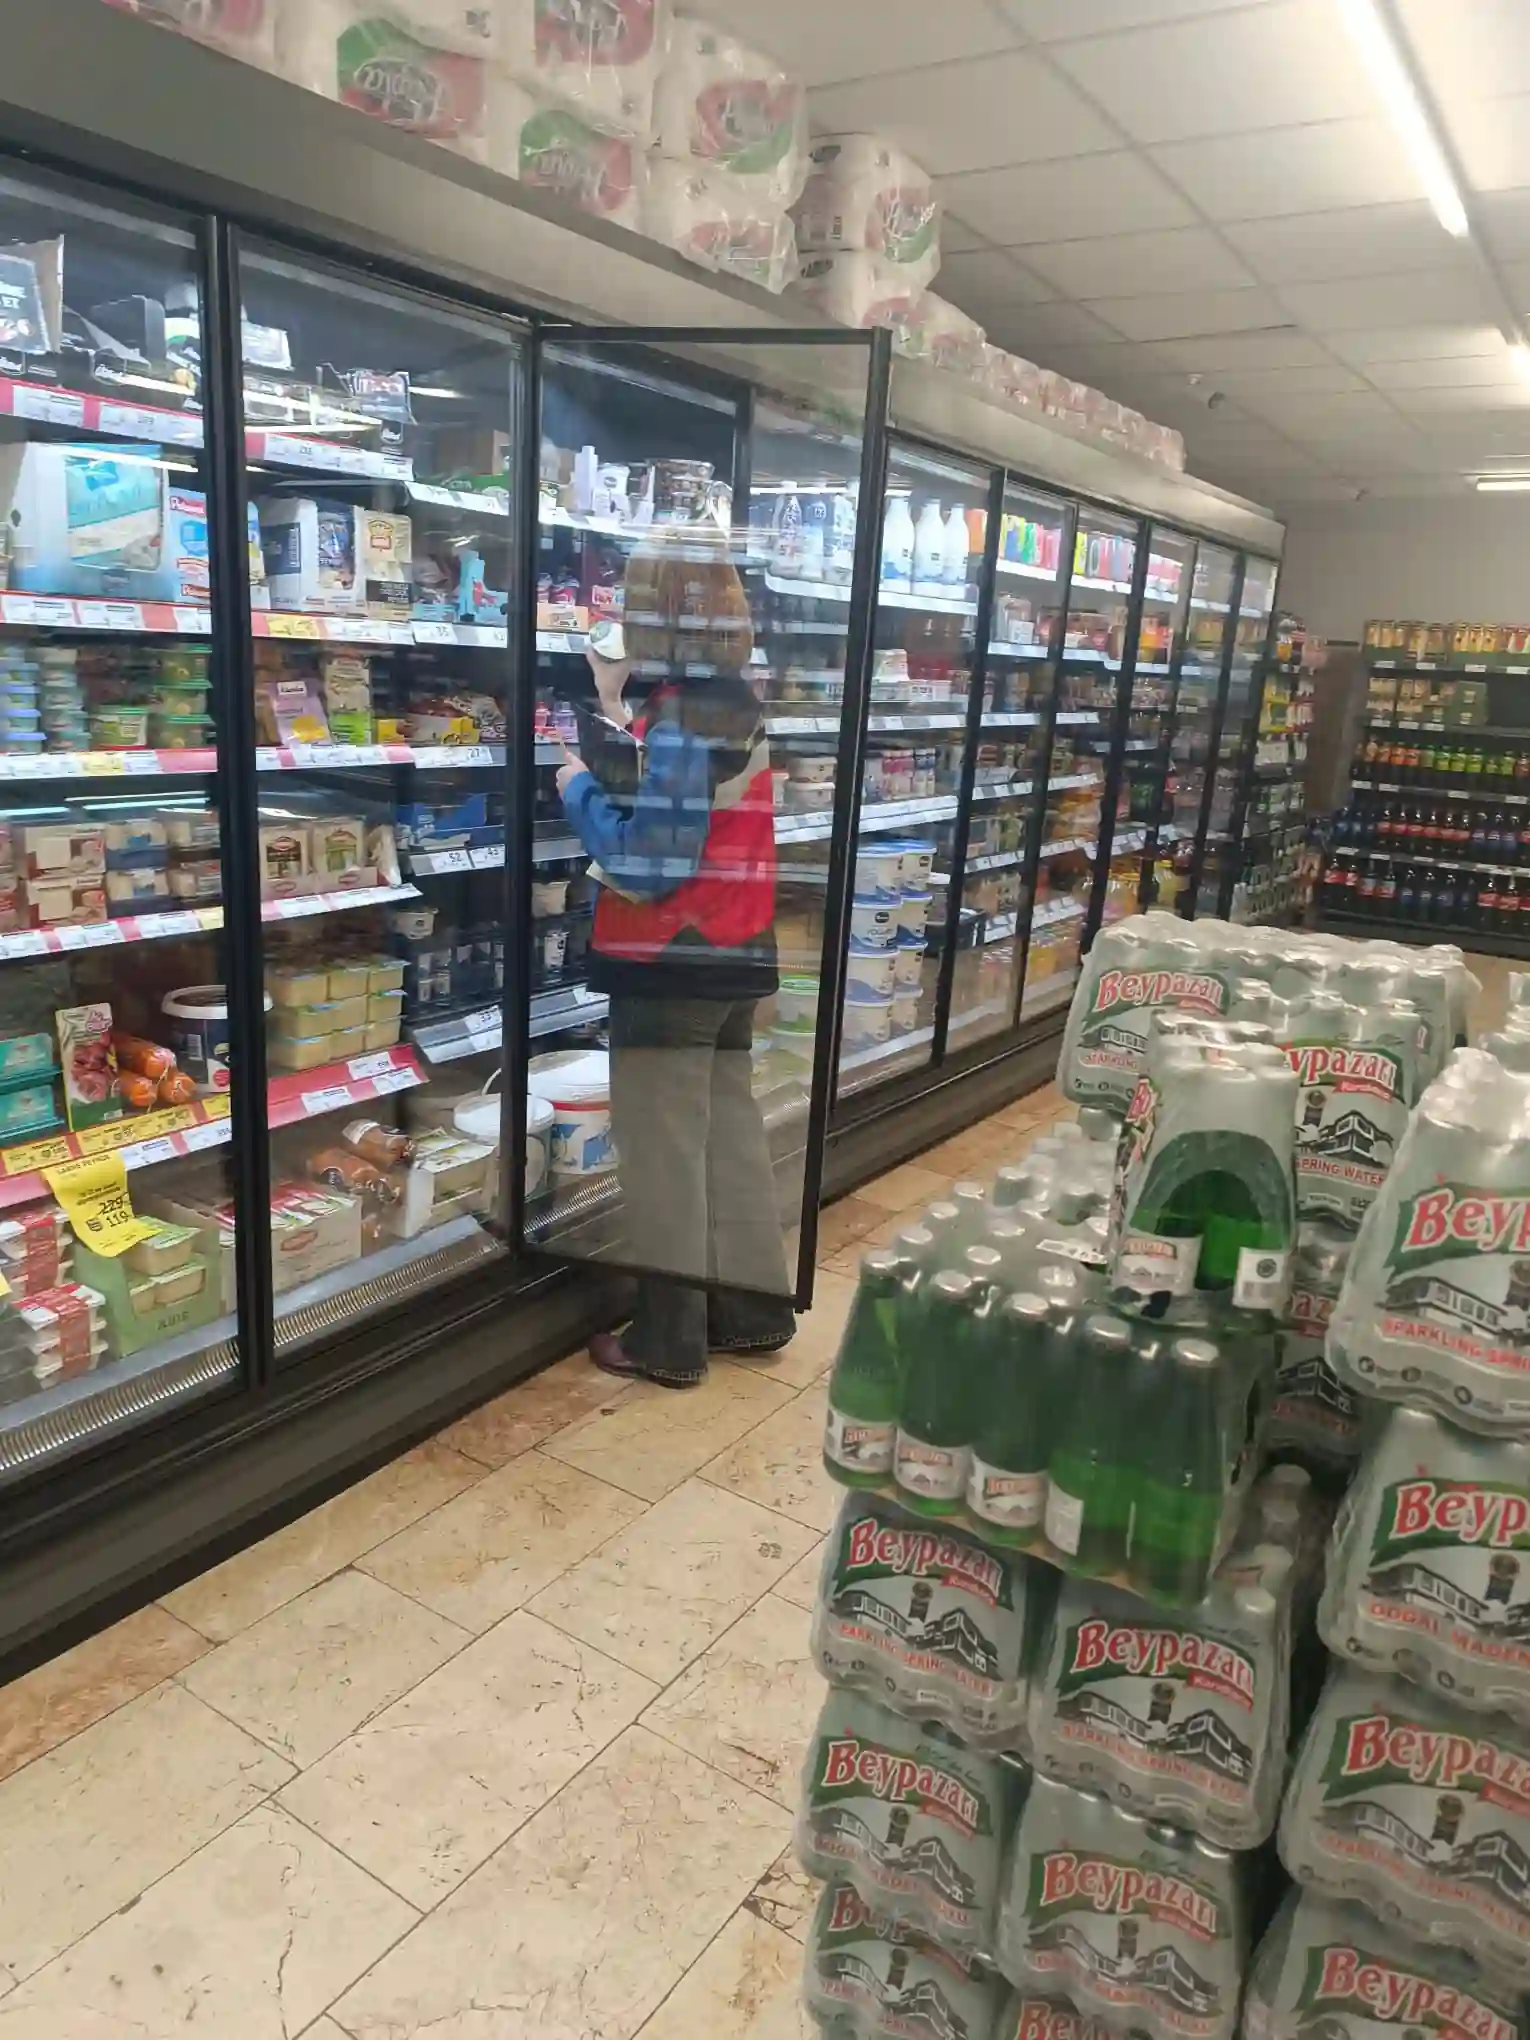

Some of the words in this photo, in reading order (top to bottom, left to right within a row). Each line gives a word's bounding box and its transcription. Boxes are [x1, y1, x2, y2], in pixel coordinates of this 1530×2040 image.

[1286, 1046, 1397, 1091] ypazarı
[847, 1517, 1003, 1598] Beypazarı
[1070, 1620, 1255, 1699] Beypazarı
[821, 1740, 980, 1828] Beypazarı
[1040, 1853, 1216, 1933] Beypazarı
